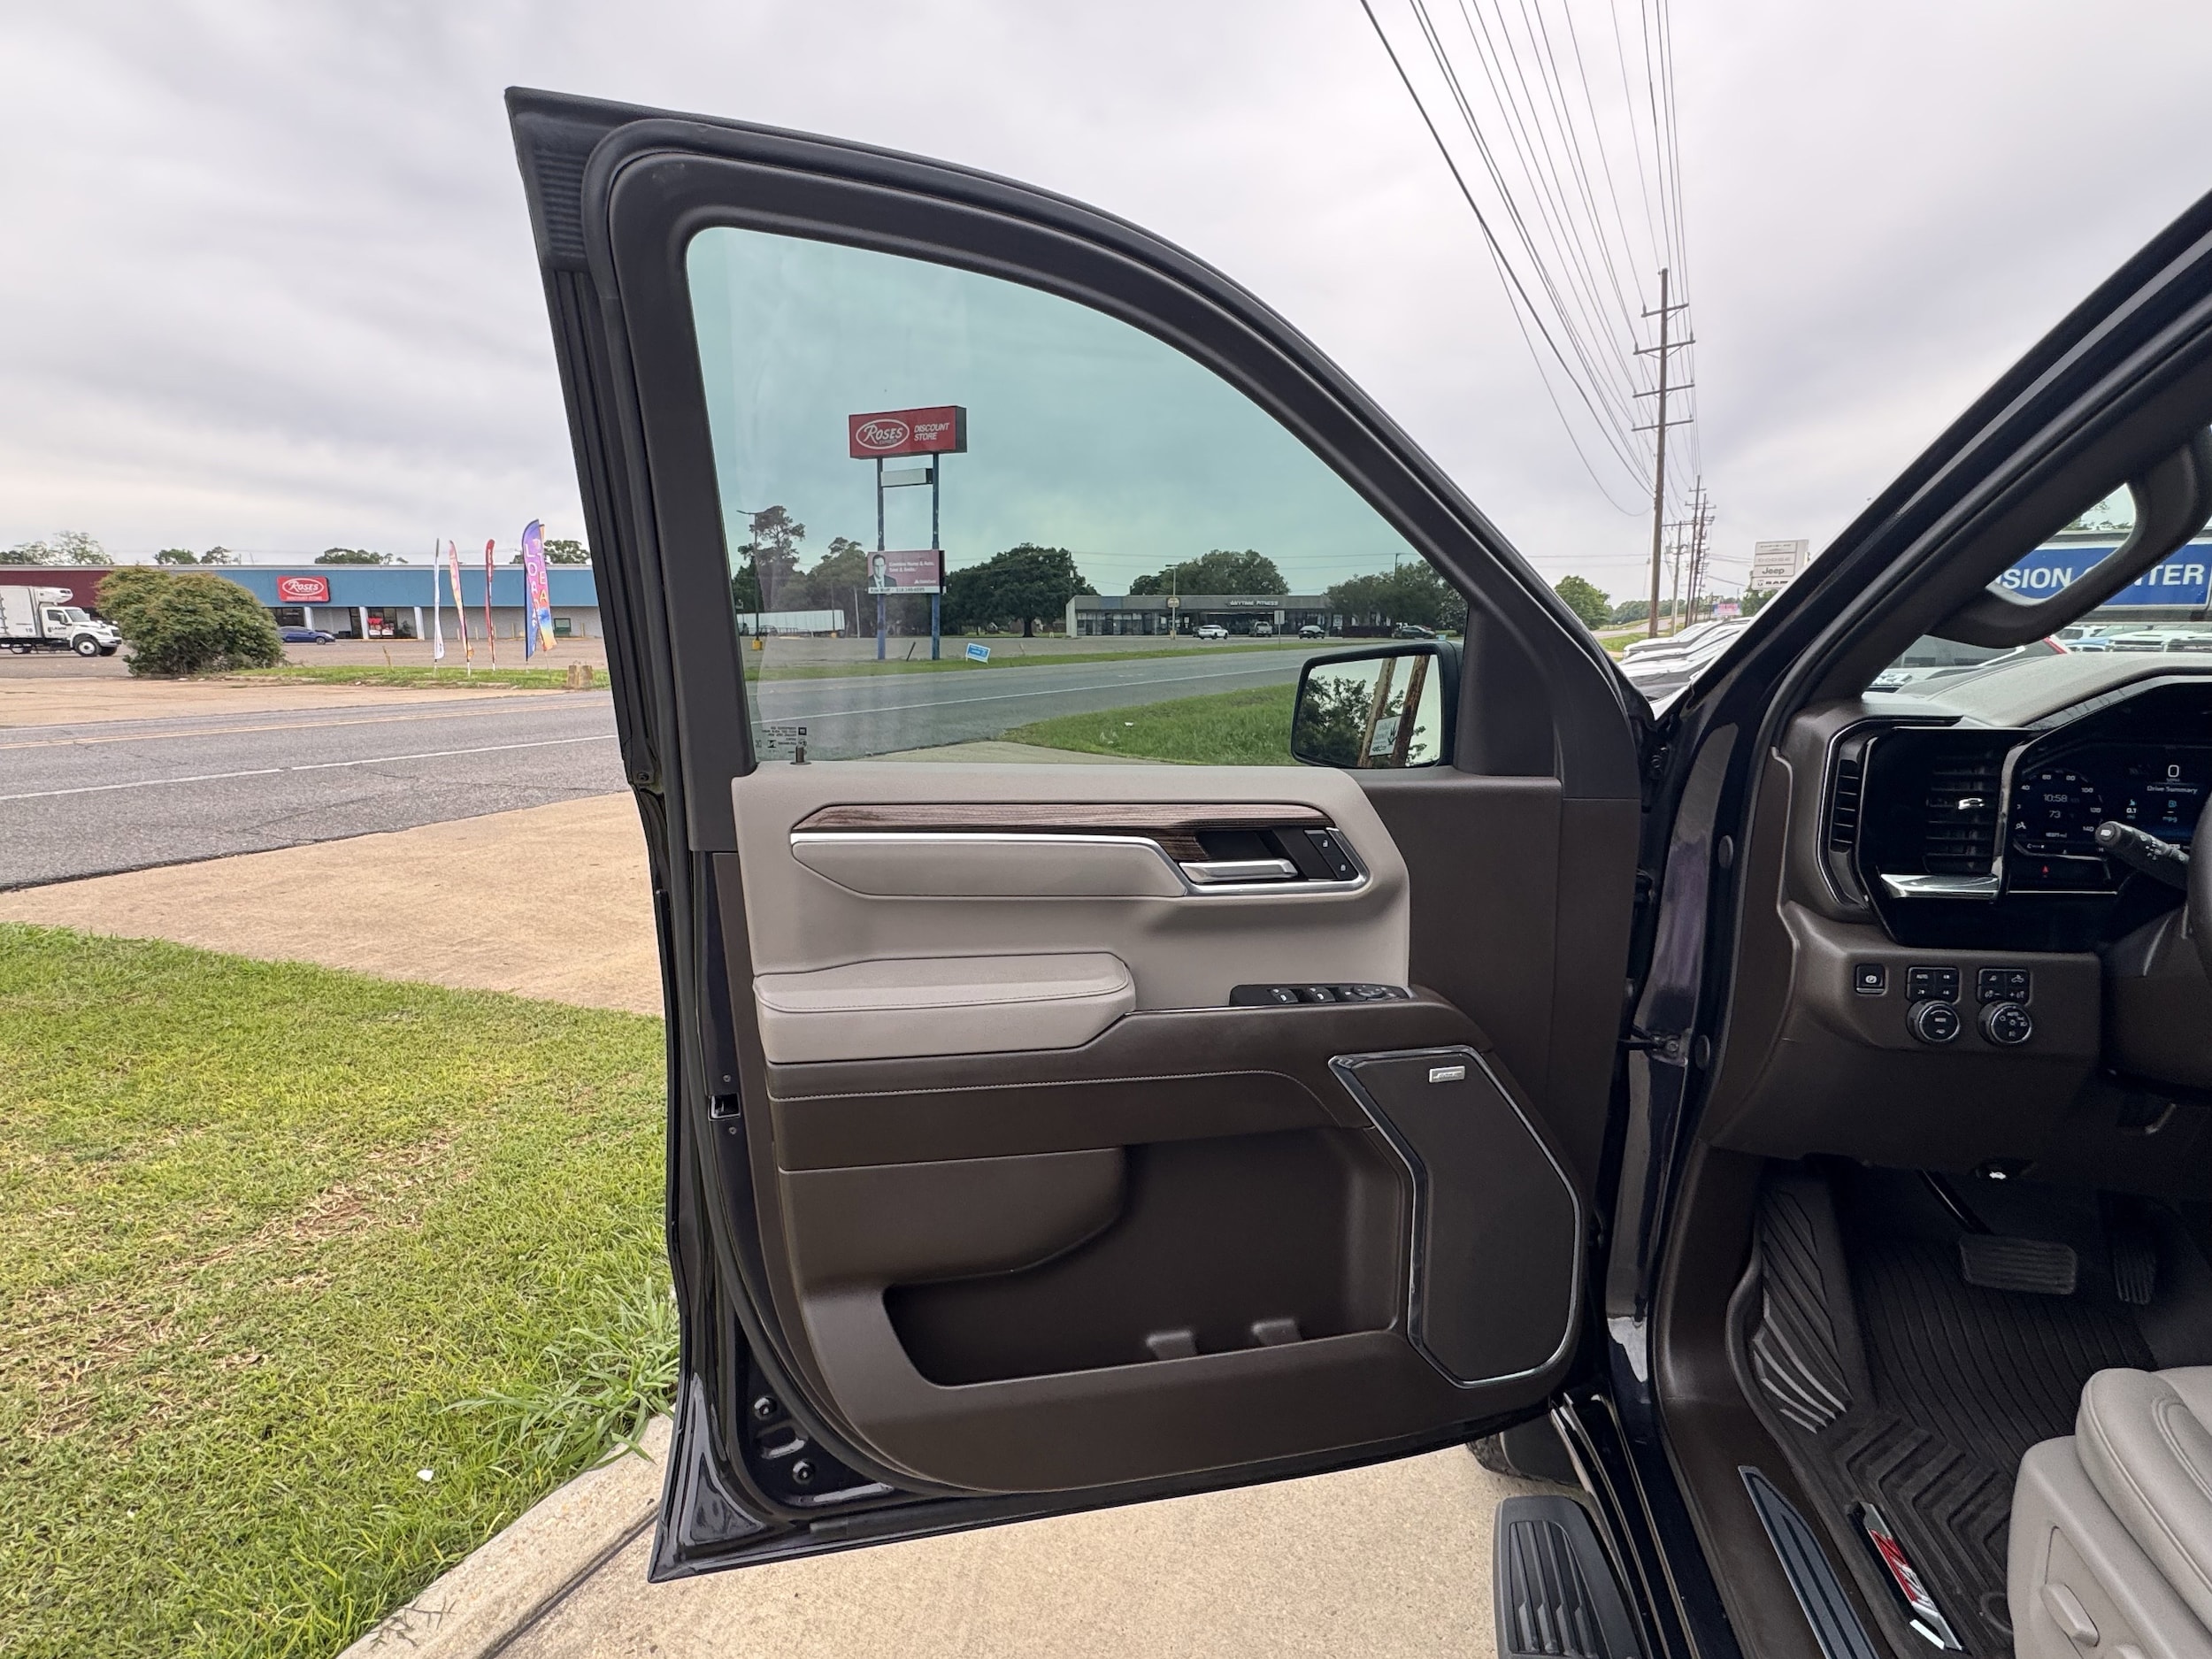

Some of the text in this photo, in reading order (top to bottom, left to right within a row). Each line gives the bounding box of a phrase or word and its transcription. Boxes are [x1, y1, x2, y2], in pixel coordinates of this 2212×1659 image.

[914, 423, 950, 433] DISCOUNT
[863, 424, 903, 444] ROSES
[914, 432, 937, 441] STORE
[1762, 566, 1785, 575] Jeep
[288, 580, 319, 593] ROSES
[2168, 764, 2180, 778] 0
[2043, 794, 2068, 803] 10:58
[2049, 810, 2061, 818] 73
